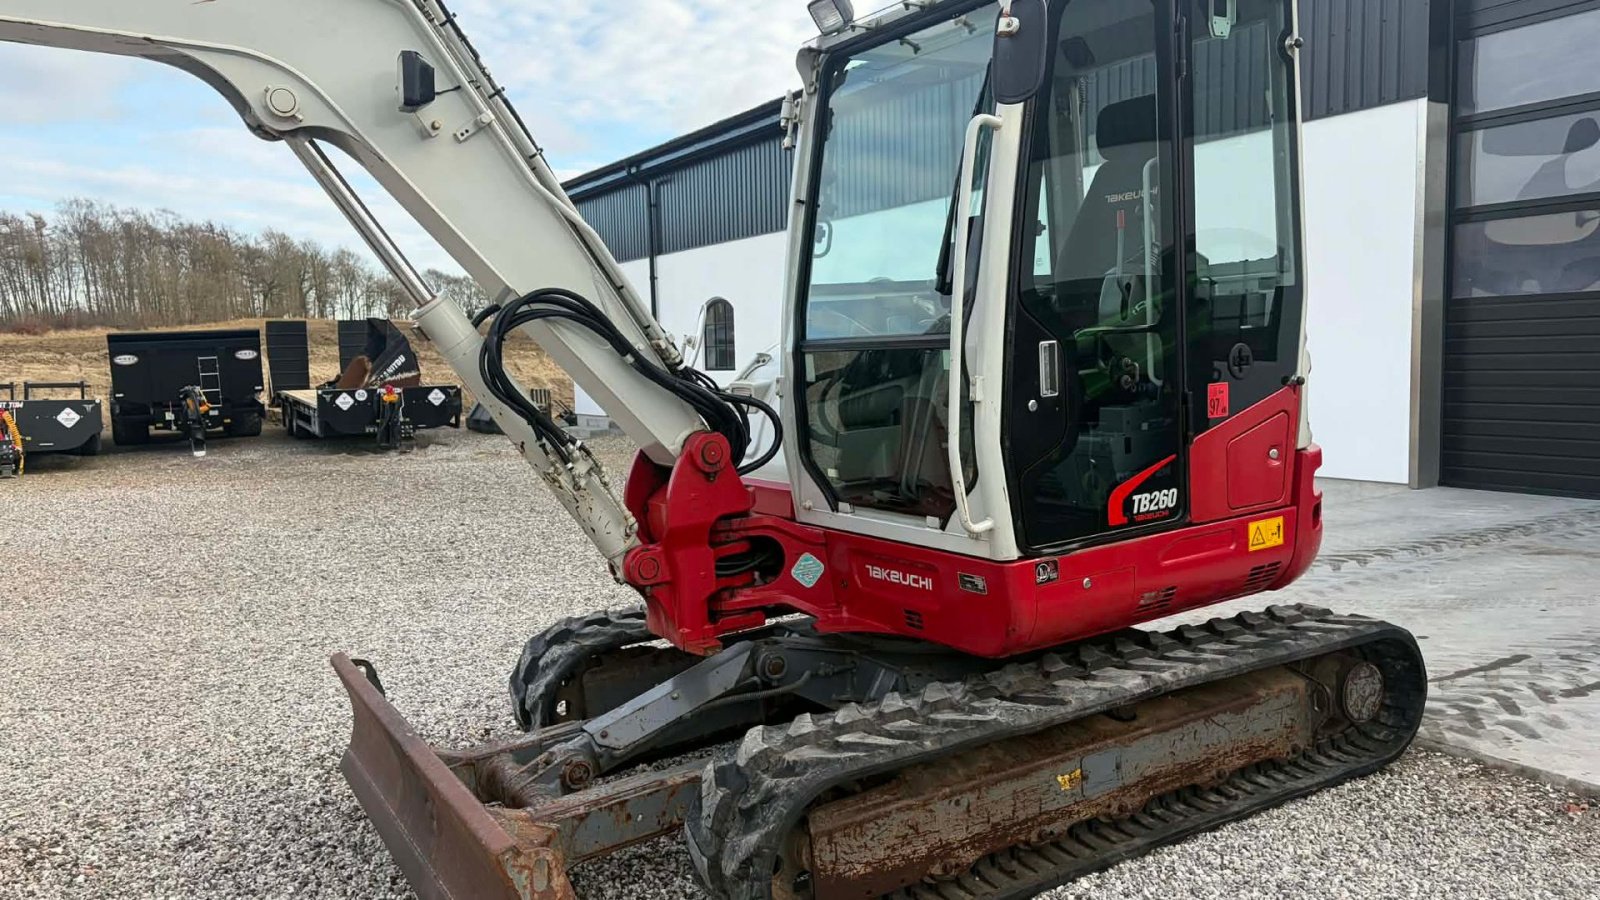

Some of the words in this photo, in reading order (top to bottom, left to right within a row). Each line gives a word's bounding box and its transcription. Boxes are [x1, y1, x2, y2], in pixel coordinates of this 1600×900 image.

[1210, 398, 1220, 416] 97
[1132, 487, 1178, 515] TB260
[865, 564, 933, 591] TAKEUCHI
